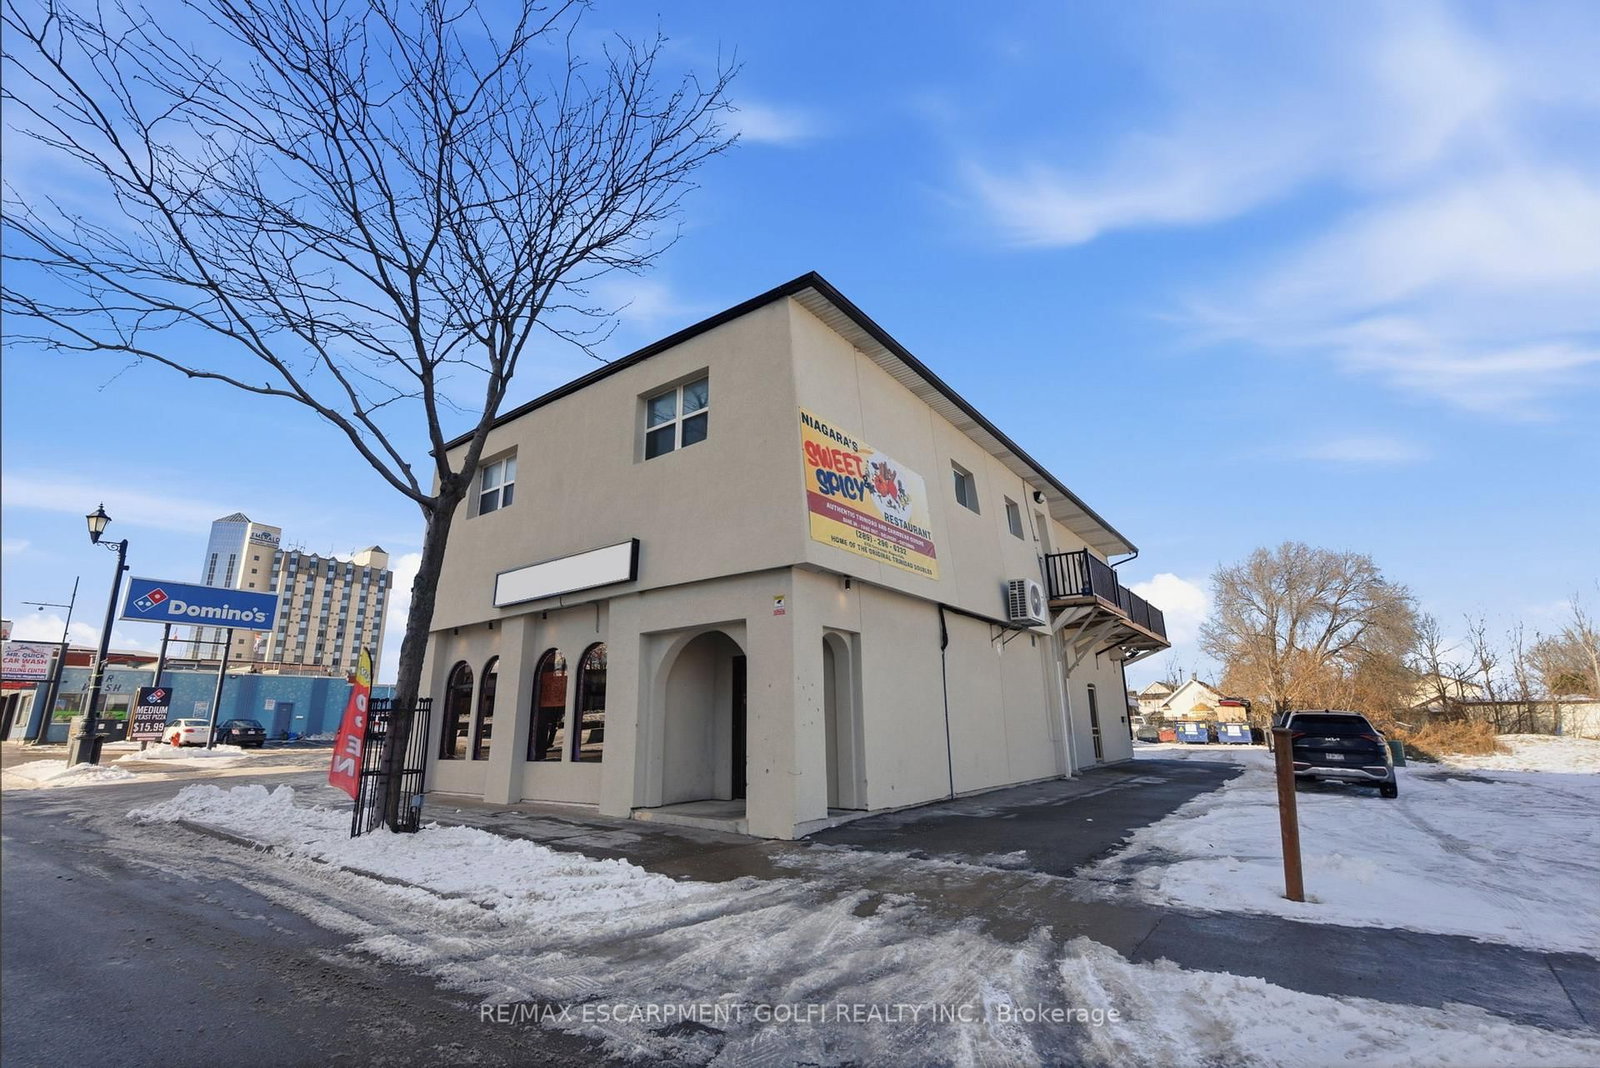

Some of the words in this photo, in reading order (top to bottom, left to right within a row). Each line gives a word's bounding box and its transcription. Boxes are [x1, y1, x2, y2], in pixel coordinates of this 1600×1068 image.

[801, 412, 858, 452] NIAGARA'S
[804, 440, 863, 478] SWEET
[816, 468, 864, 502] SPICY
[826, 502, 856, 519] AUTHENTIC
[856, 513, 878, 527] TRINIDAD
[884, 512, 931, 540] RESTAURANT
[831, 535, 848, 546] HOME
[849, 541, 856, 549] OF
[857, 544, 868, 553] THE
[869, 548, 891, 561] ORIGINAL
[892, 556, 914, 569] TRINIDAD
[168, 599, 266, 623] Domino's
[136, 705, 168, 714] MEDIUM
[133, 722, 165, 732] $15.99
